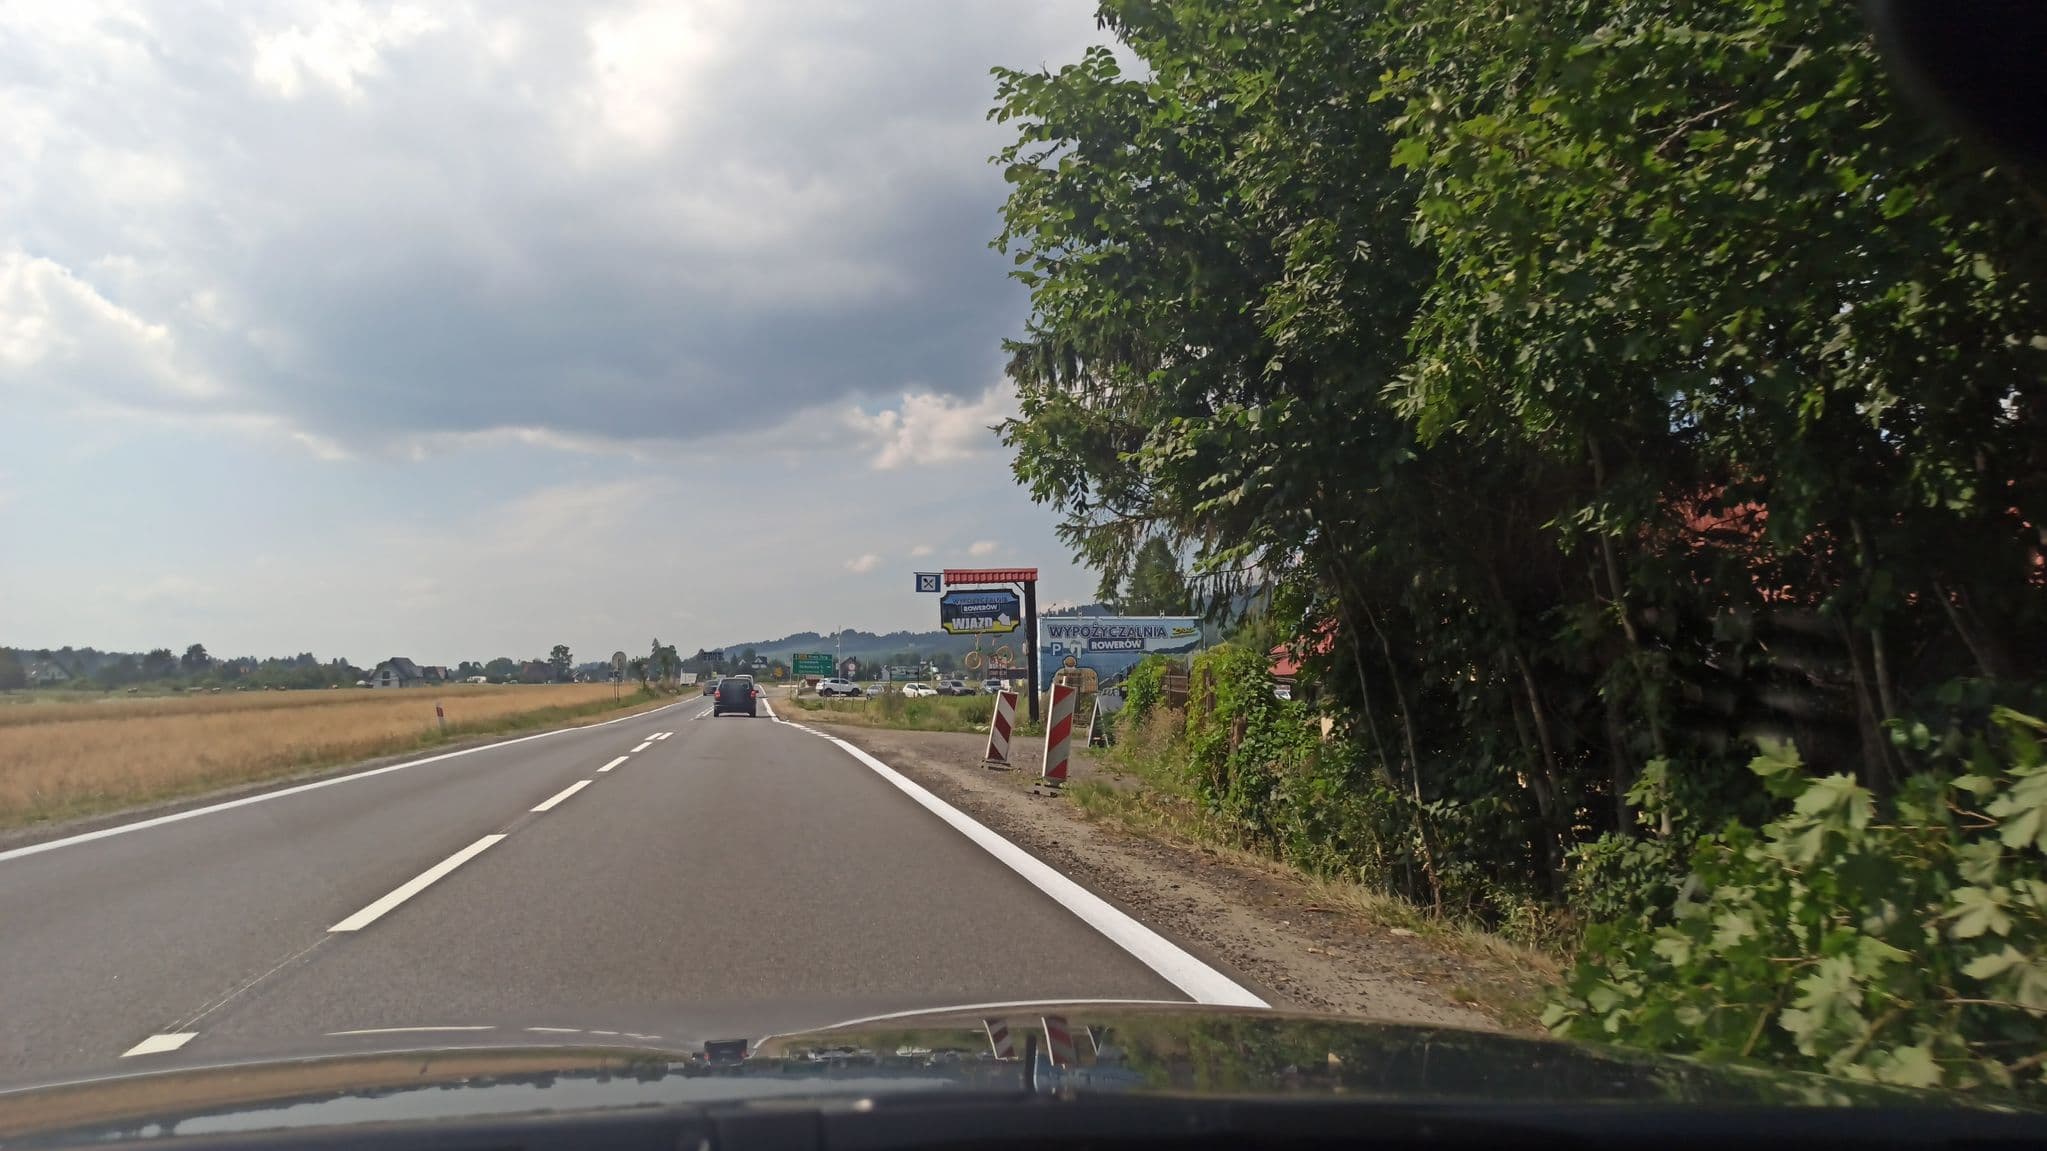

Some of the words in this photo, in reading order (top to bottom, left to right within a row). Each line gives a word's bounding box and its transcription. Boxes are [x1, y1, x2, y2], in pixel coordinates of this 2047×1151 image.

[963, 604, 998, 612] ROWERÓW
[952, 617, 993, 630] WJAZD
[1049, 622, 1168, 639] WYPOŻYCZALNIA
[1091, 638, 1142, 650] ROWERÓW
